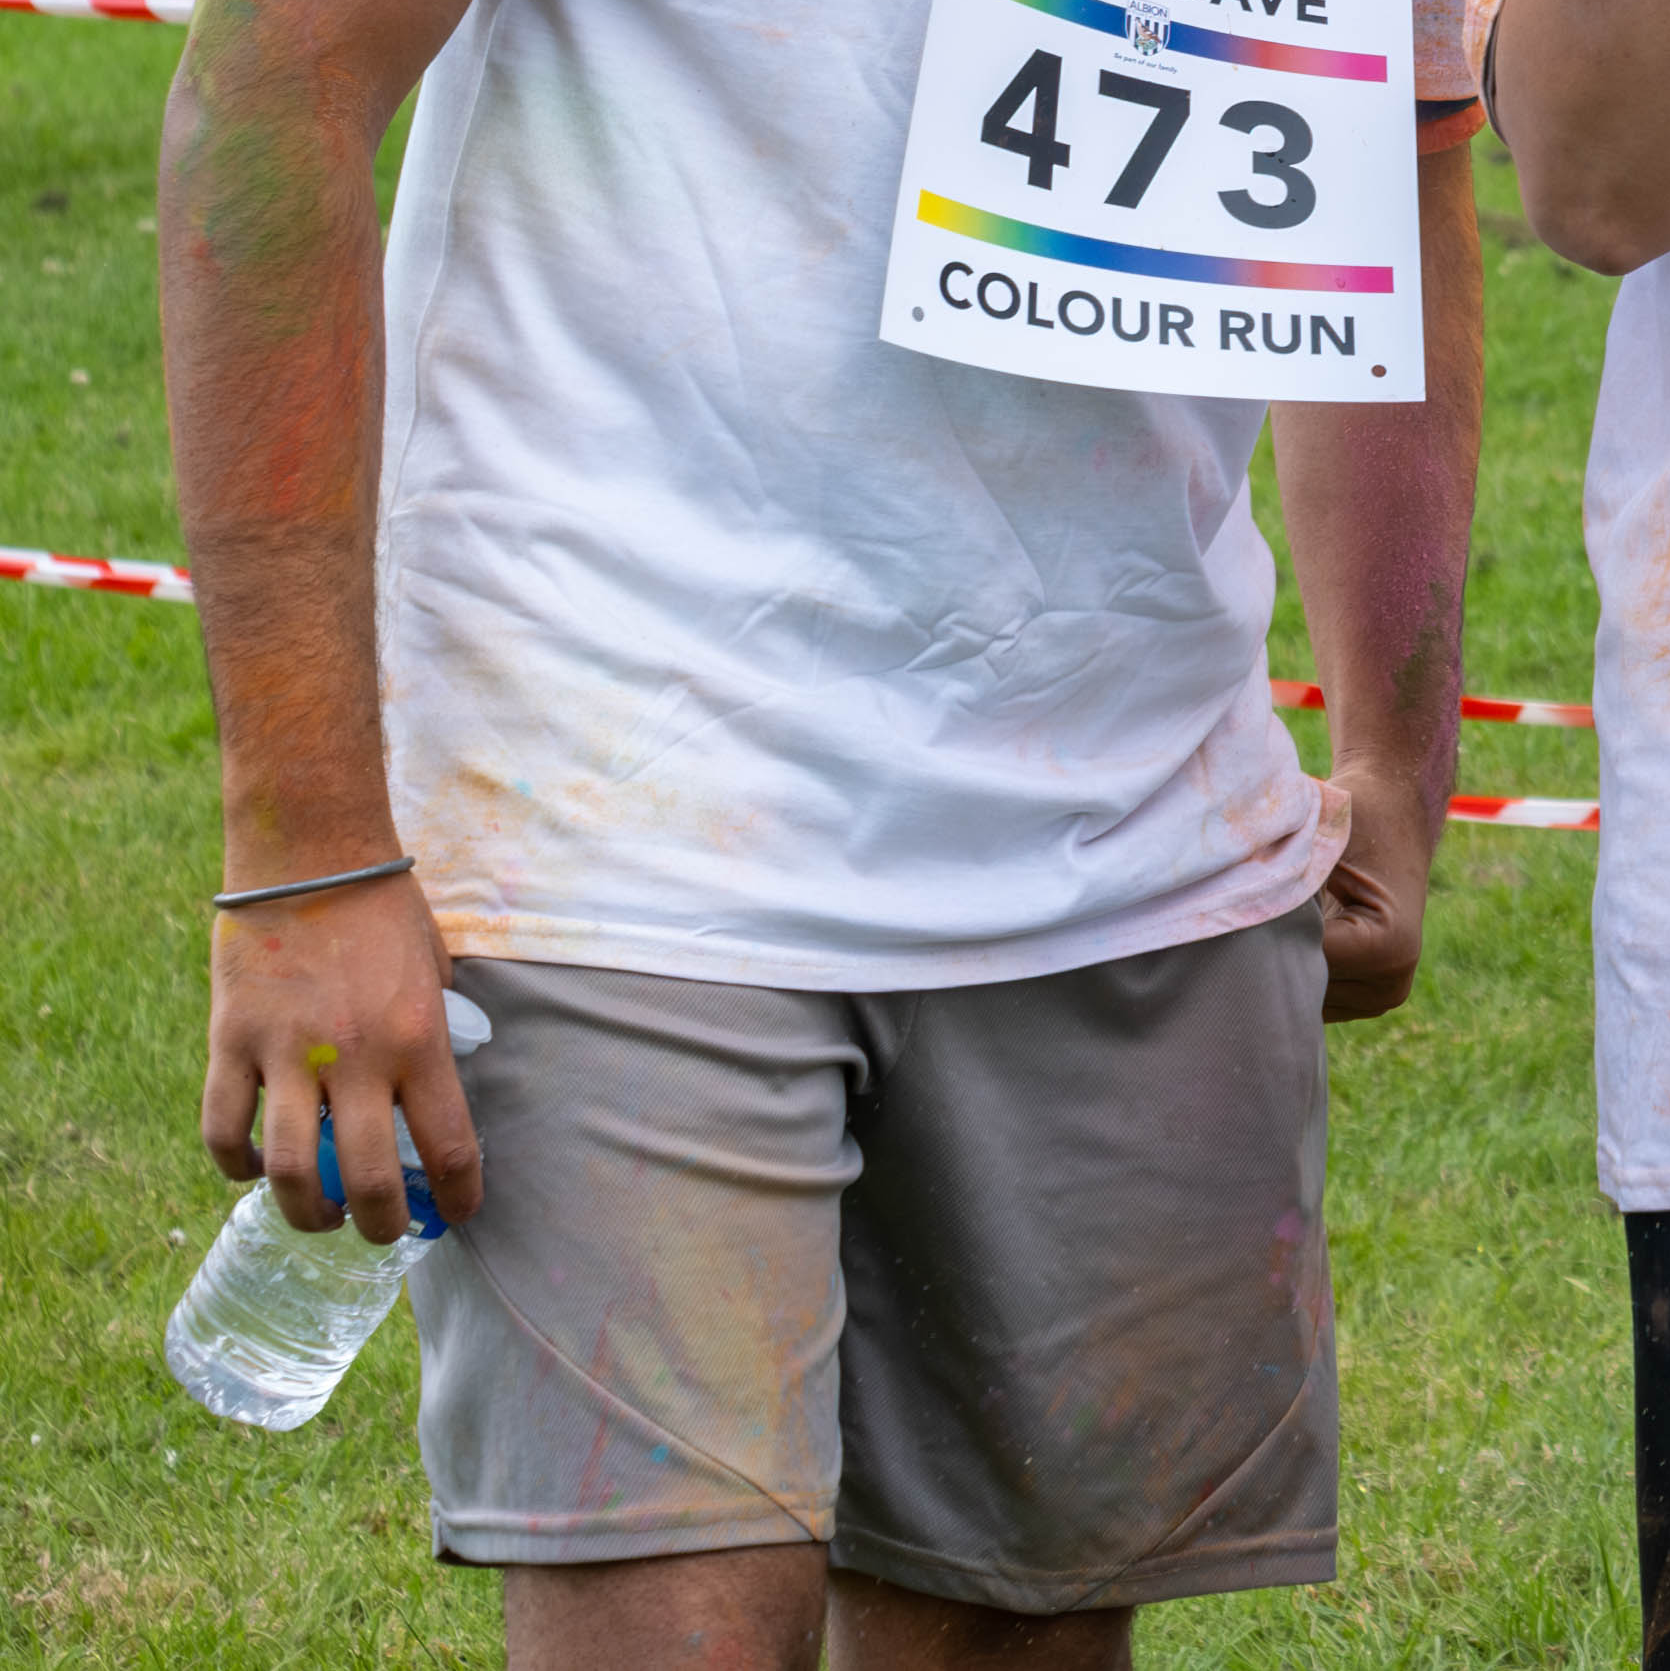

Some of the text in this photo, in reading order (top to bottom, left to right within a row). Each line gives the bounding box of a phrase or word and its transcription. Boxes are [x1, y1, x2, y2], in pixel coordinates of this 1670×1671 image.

[1129, 0, 1168, 18] ALBION
[979, 47, 1317, 230] 473
[938, 260, 1356, 357] COLOUR RUN
